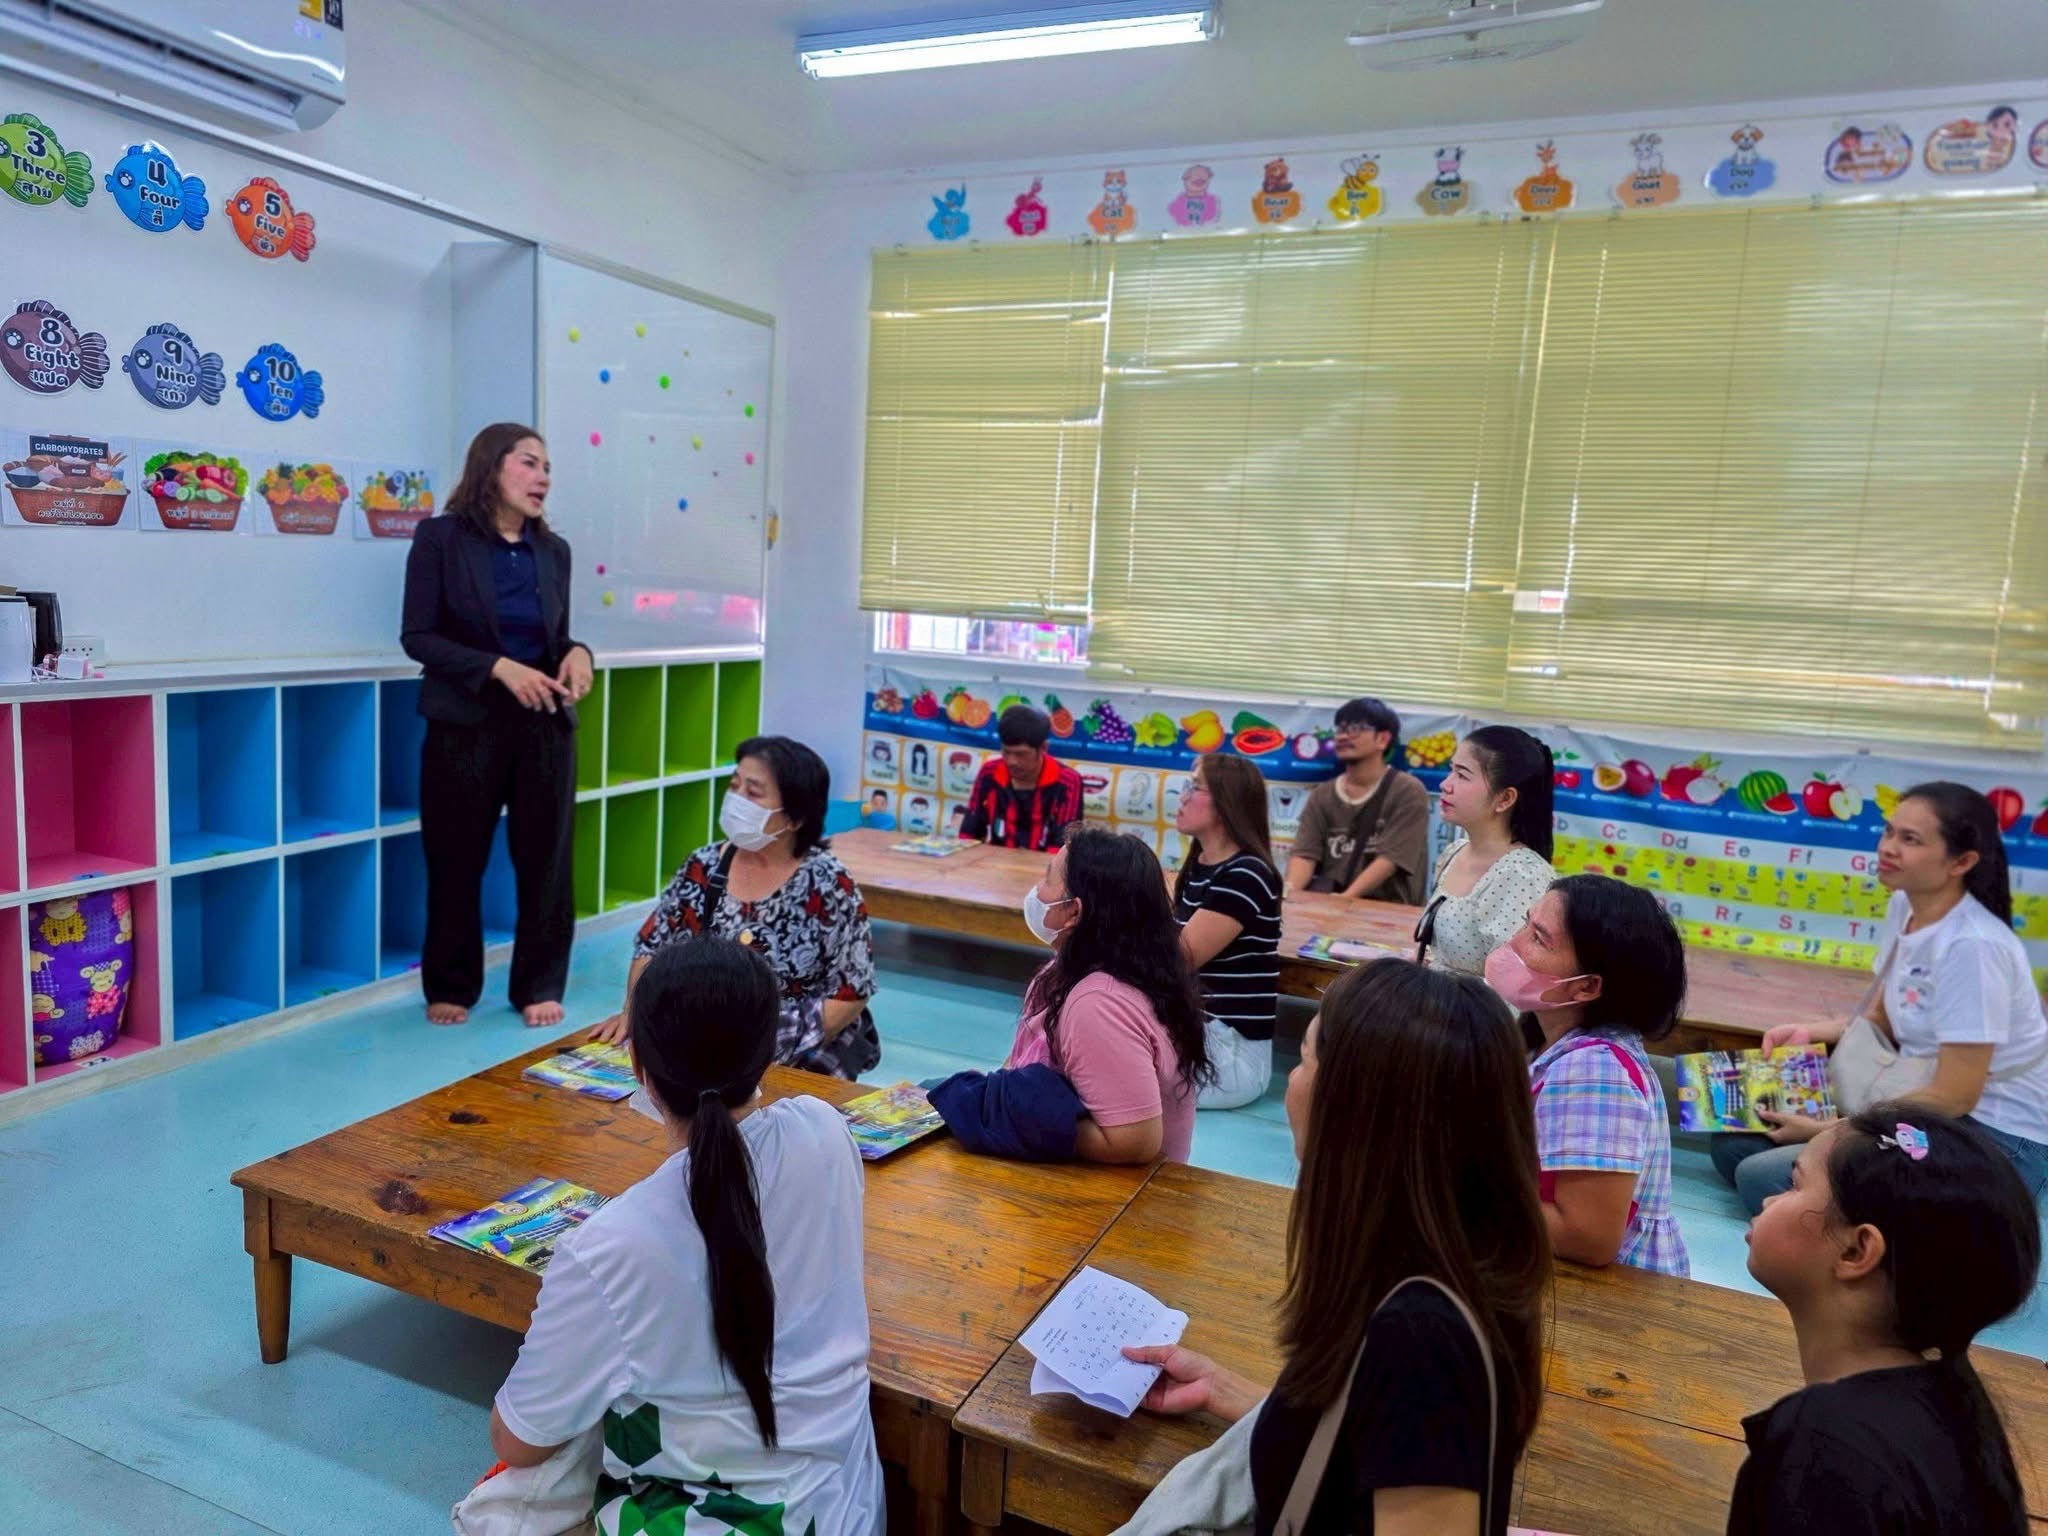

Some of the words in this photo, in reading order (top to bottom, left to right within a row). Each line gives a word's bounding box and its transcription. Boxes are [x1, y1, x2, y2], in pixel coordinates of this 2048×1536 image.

[27, 130, 47, 157] 3
[11, 153, 66, 184] Three
[148, 160, 168, 186] 4
[1729, 168, 1755, 178] Dog
[22, 182, 52, 199] สาม
[140, 186, 181, 209] Four
[1431, 187, 1461, 200] Cow
[153, 206, 163, 226] สี่
[265, 192, 281, 217] 5
[255, 215, 285, 238] Five
[39, 318, 64, 346] 8
[25, 344, 81, 369] Eight
[164, 339, 183, 365] 9
[33, 371, 69, 387] แปด
[156, 364, 197, 386] Nine
[265, 357, 295, 383] 10
[163, 385, 186, 403] เก้า
[267, 381, 293, 400] Ten
[34, 442, 104, 456] CARBOHYDRATES
